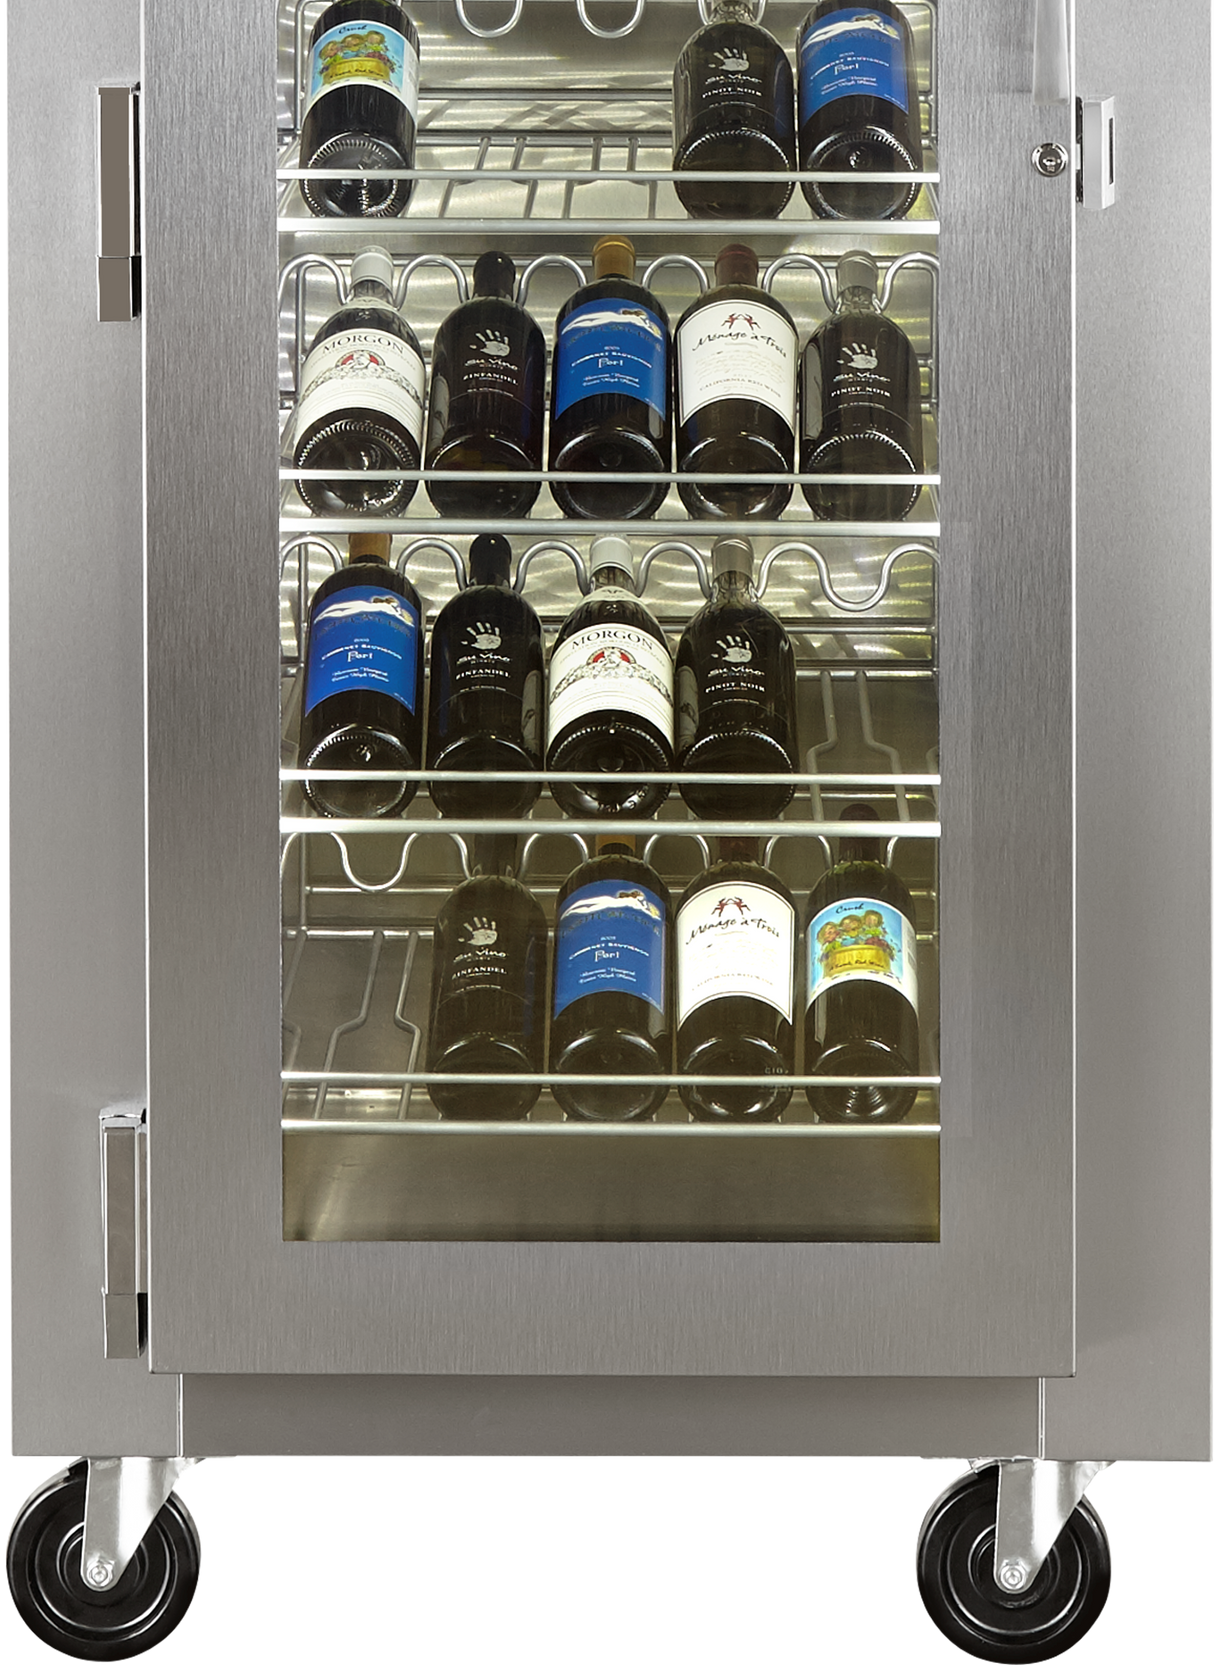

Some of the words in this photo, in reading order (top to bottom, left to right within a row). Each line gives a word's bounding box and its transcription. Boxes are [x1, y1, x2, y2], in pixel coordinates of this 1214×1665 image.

[702, 87, 732, 98] PINOT
[737, 87, 762, 96] NOIR
[322, 334, 404, 354] MORGON
[463, 372, 518, 385] ZINFANDEL
[831, 386, 862, 397] PINOT
[865, 386, 891, 397] NOIR
[572, 630, 653, 651] MORGON
[455, 669, 511, 680] ZINFANDEL
[705, 681, 735, 693] PINOT
[740, 681, 766, 692] NOIR
[451, 966, 507, 980] ZINFANDEL
